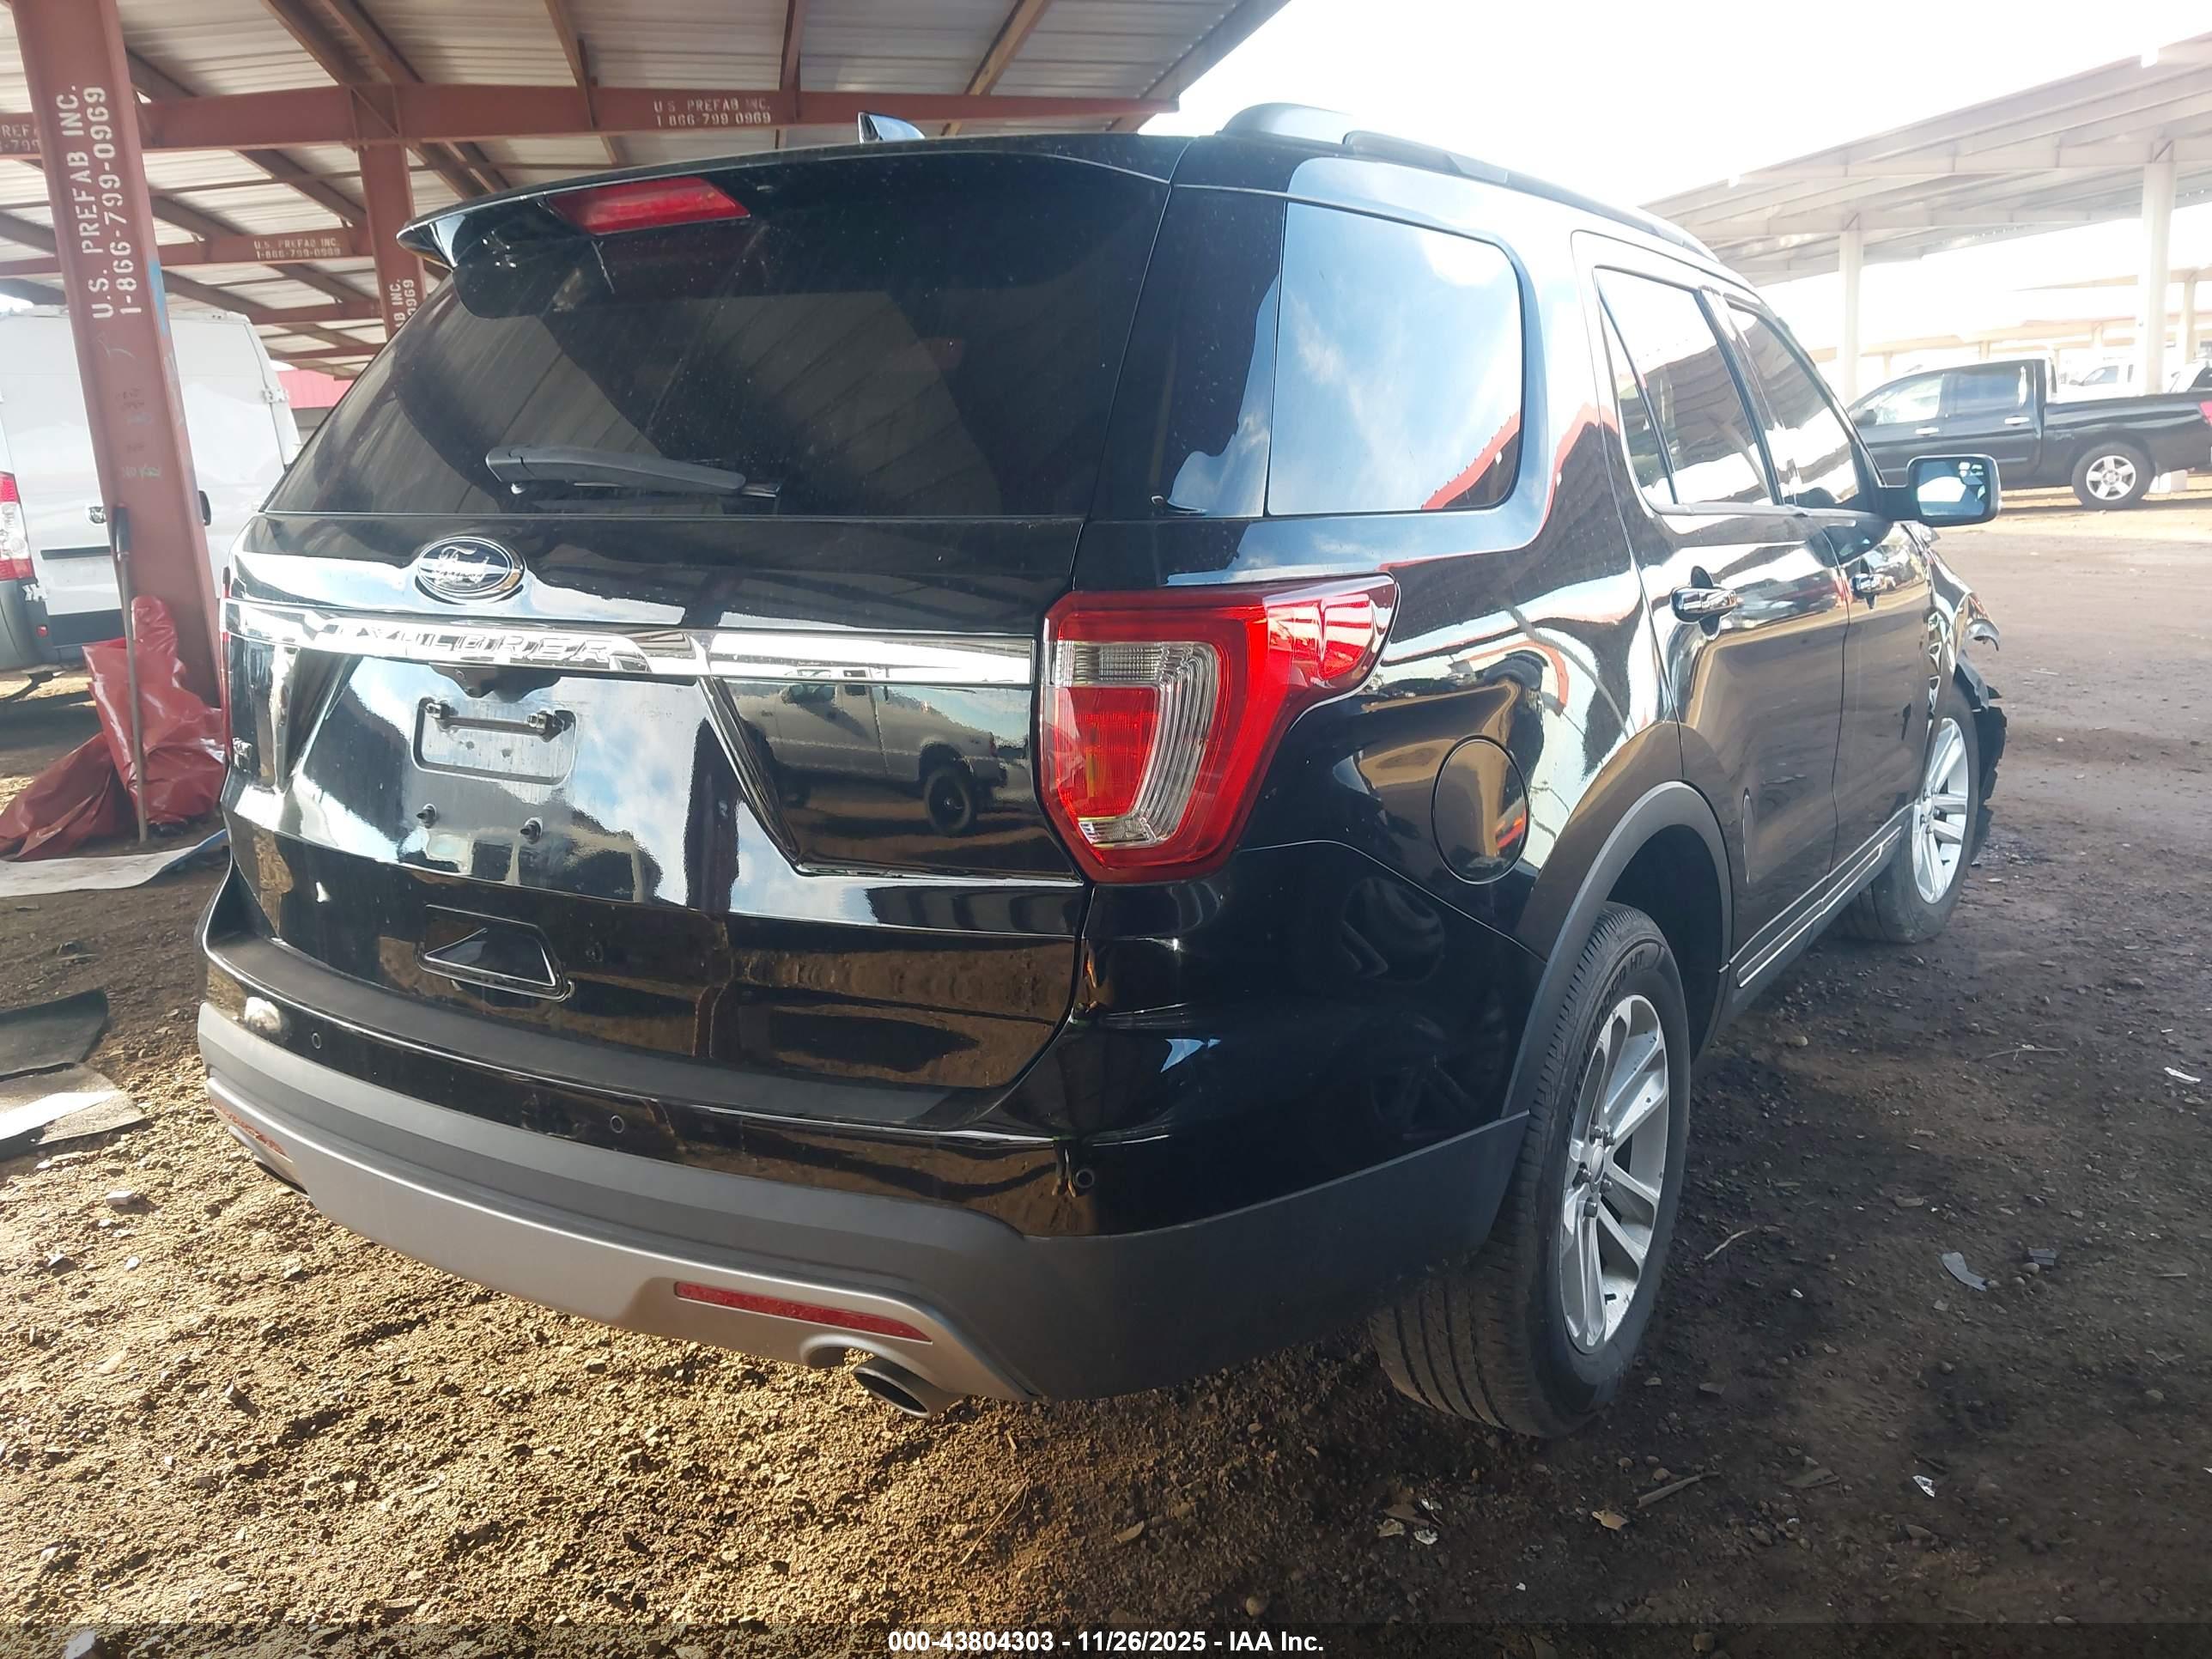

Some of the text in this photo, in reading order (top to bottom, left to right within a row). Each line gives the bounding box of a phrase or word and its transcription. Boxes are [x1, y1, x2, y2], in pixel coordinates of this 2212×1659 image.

[687, 98, 739, 111] PREFAB
[56, 85, 113, 319] U.S. PREFAB INC.
[83, 87, 142, 314] 1-866-799-0969
[389, 279, 404, 306] INC.
